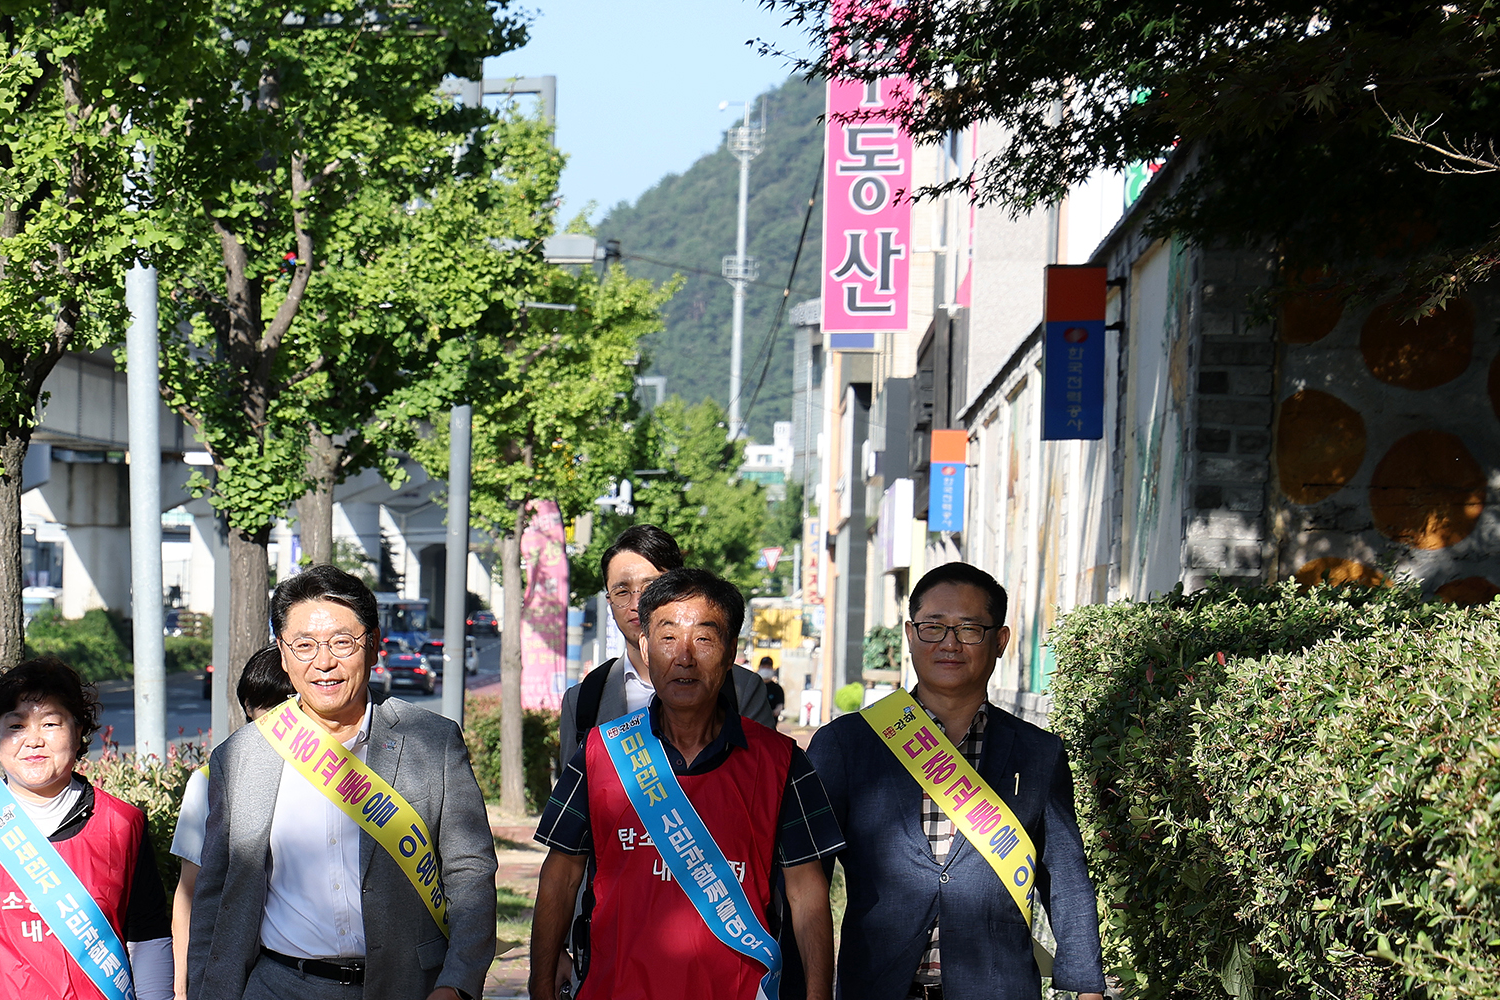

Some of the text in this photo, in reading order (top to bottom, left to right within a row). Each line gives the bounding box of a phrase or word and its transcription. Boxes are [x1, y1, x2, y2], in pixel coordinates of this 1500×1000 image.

[1066, 346, 1084, 432] 한국전력공사
[893, 710, 917, 731] 김해
[619, 731, 668, 807] 미세먼지
[271, 706, 449, 926] 대중교통을 이용
[902, 725, 1037, 909] 대중교통을 이
[0, 826, 62, 895] 미세먼지
